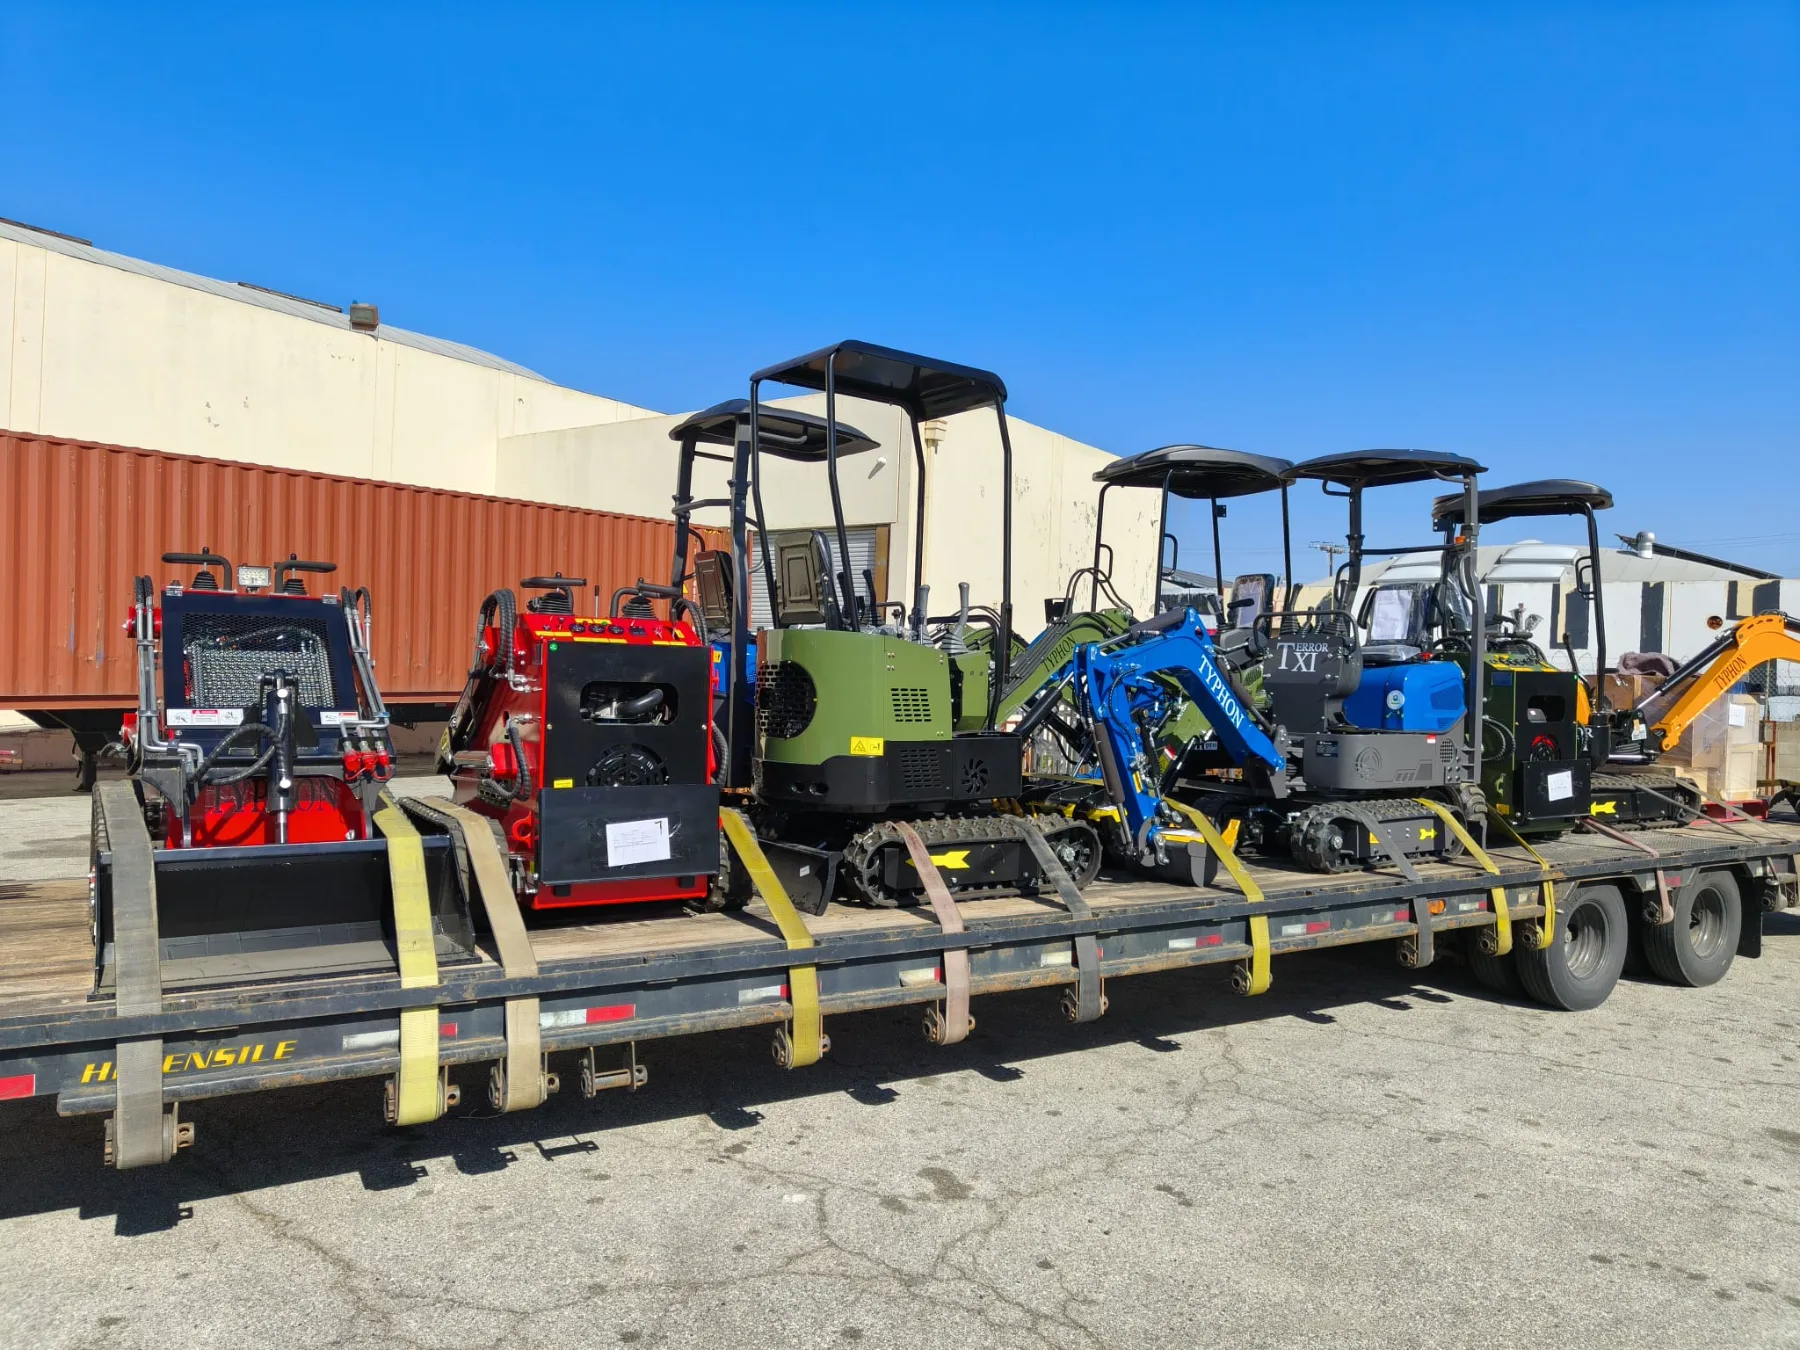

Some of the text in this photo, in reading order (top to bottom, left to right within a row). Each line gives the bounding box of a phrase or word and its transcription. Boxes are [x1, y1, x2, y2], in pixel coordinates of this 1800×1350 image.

[1042, 633, 1076, 673] TYPHON
[1276, 642, 1329, 670] TERROR
[1291, 651, 1319, 673] XI
[1713, 653, 1747, 690] TYPHON
[1198, 654, 1245, 729] TYPHON
[209, 775, 339, 813] TYPON
